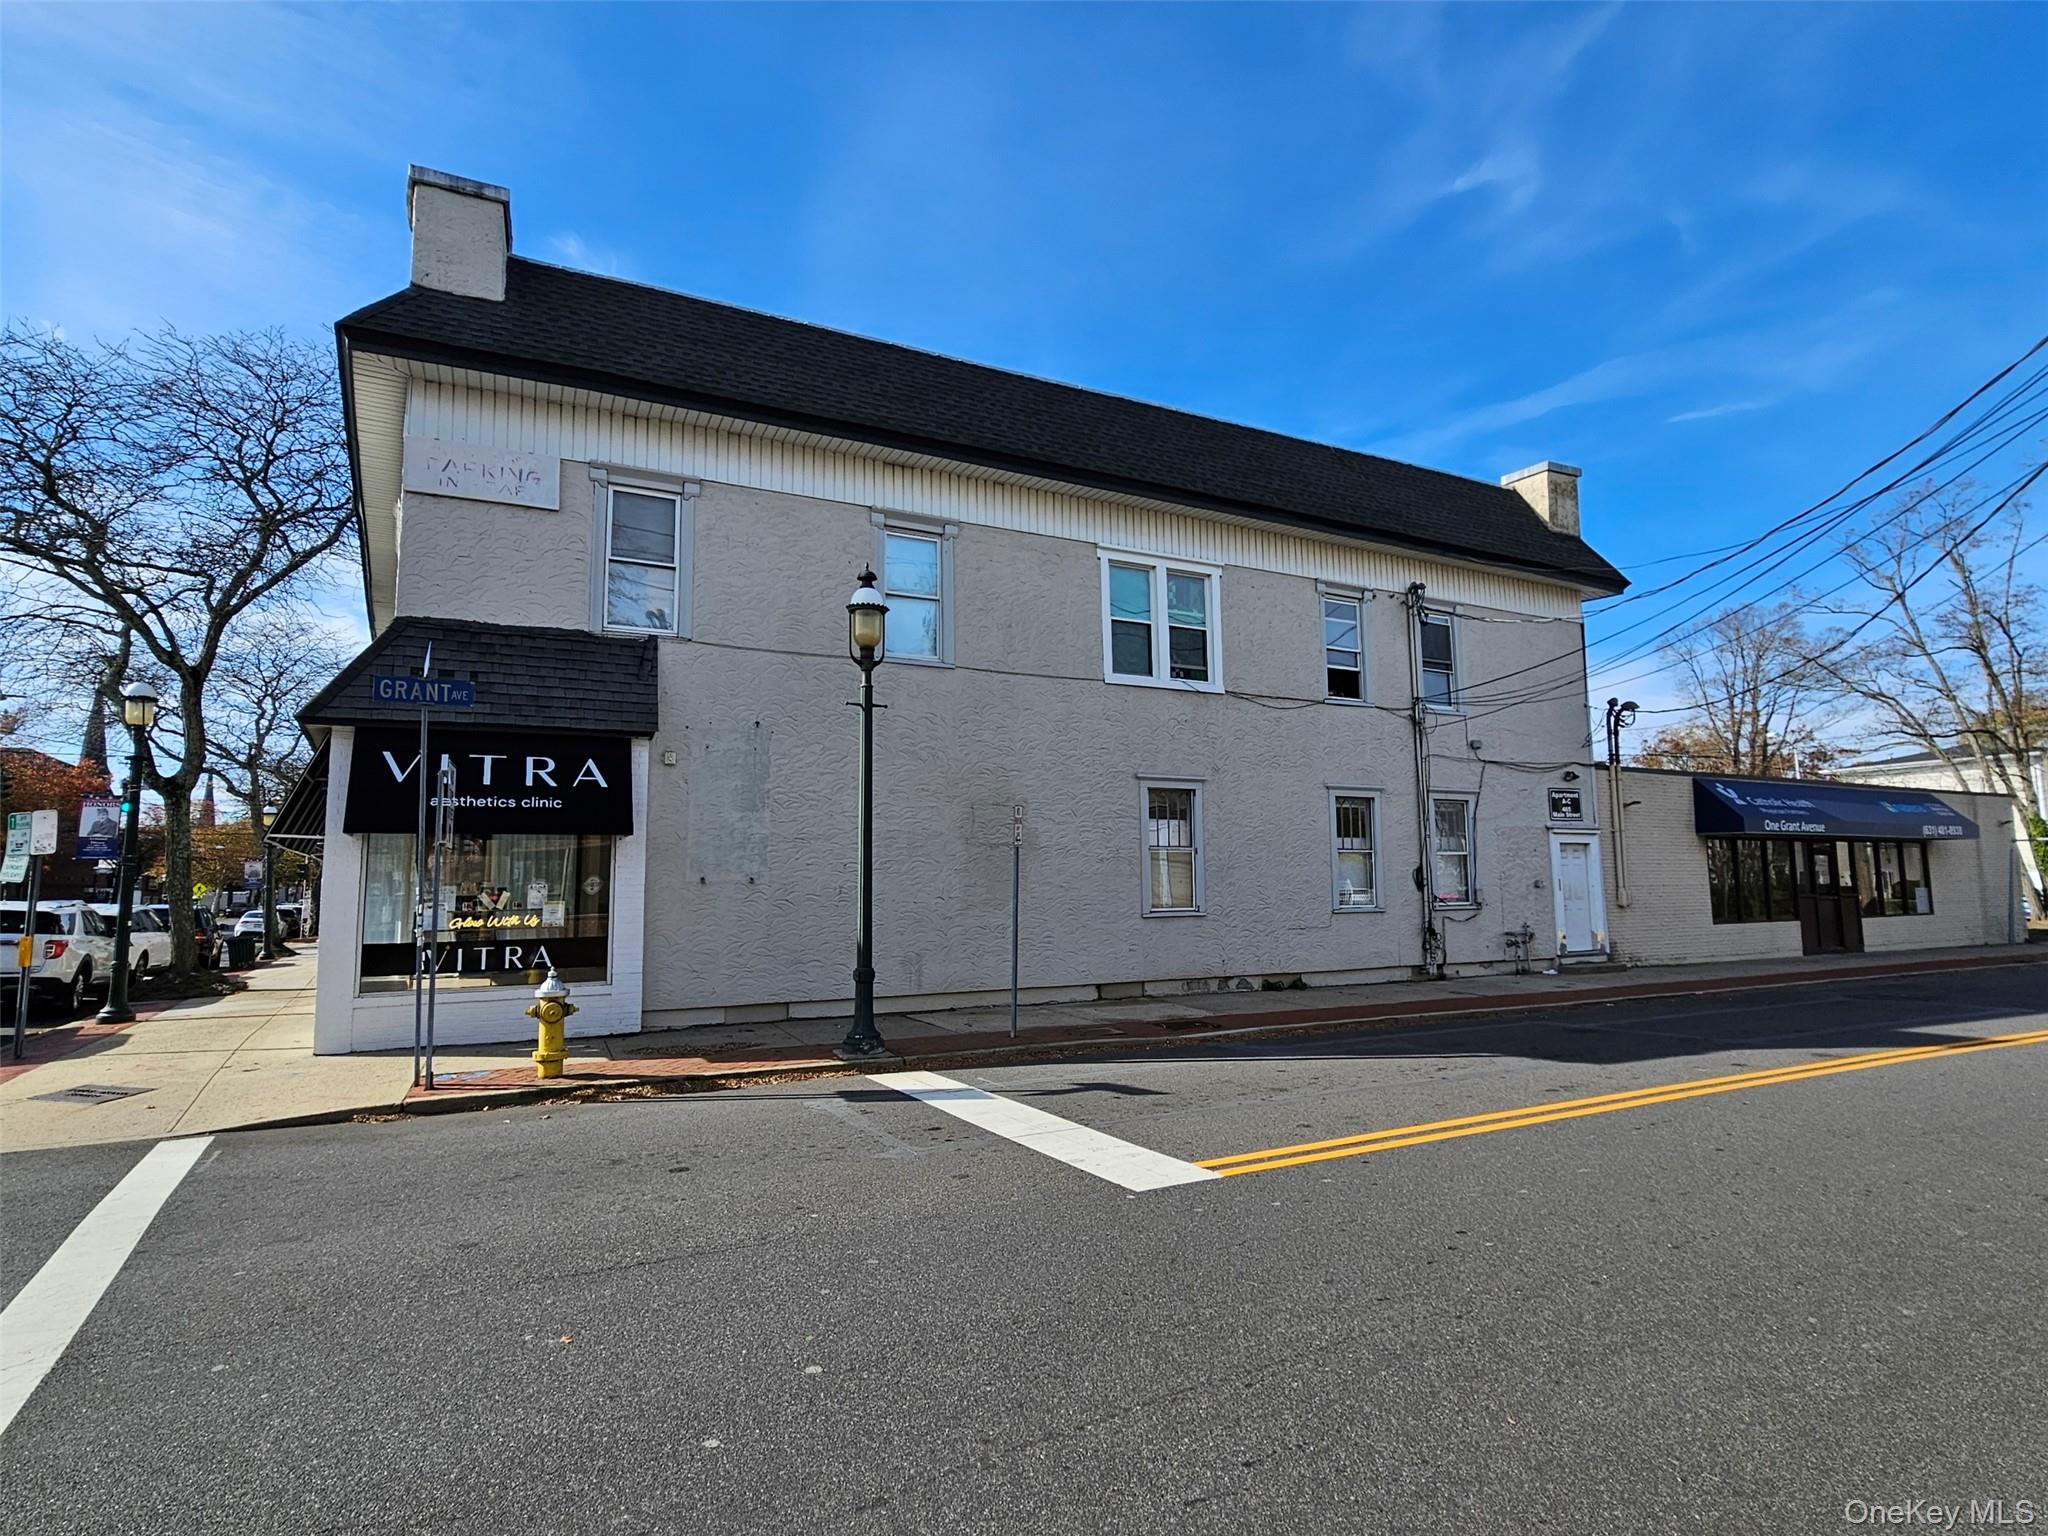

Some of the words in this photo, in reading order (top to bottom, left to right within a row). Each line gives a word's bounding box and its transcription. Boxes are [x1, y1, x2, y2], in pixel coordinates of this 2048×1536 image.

[380, 680, 452, 702] GRANT
[451, 690, 469, 701] AVE
[382, 751, 609, 788] VITRA
[430, 795, 516, 808] aesthetics
[521, 796, 563, 809] clinic
[1764, 820, 1780, 831] One
[1780, 820, 1801, 832] Grant
[1801, 822, 1826, 832] Avenue
[487, 914, 521, 928] With
[425, 945, 552, 972] VITRA
